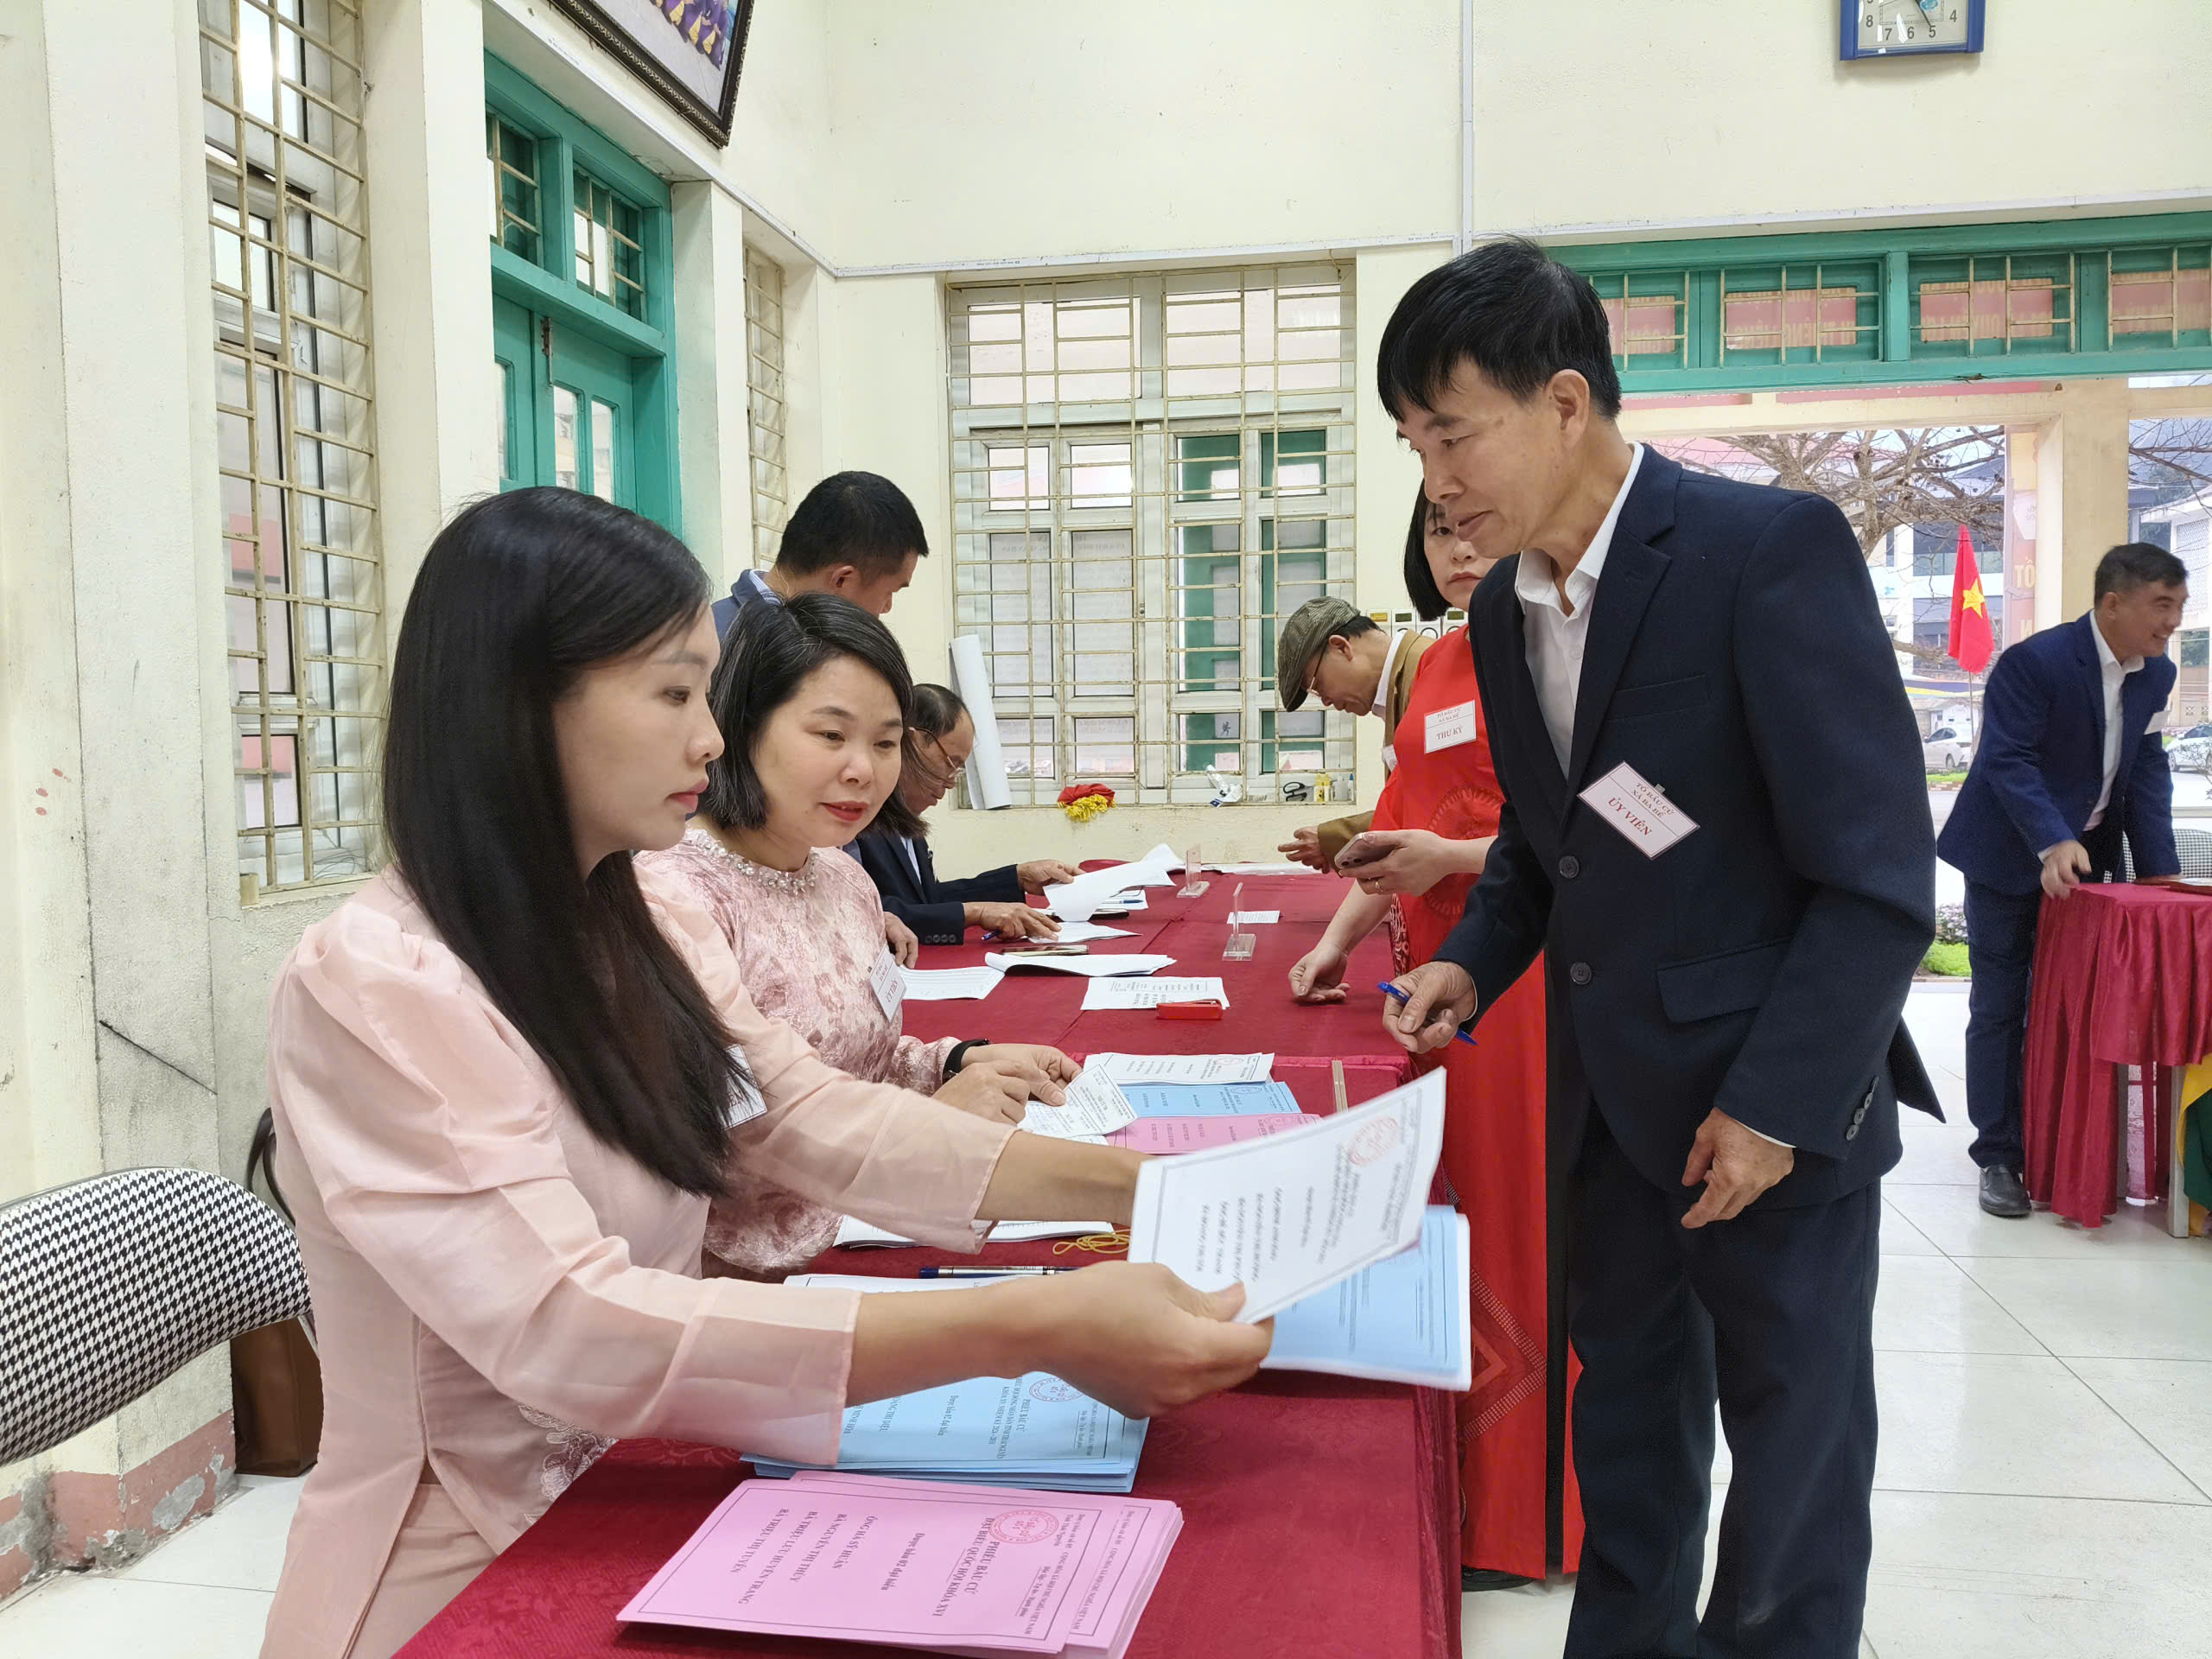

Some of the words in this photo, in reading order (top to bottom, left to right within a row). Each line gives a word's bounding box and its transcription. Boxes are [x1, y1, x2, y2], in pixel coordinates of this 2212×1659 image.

[1866, 15, 1873, 27] 8
[1949, 10, 1958, 22] 4
[1885, 28, 1892, 41] 7
[1907, 26, 1915, 39] 6
[1929, 25, 1936, 38] 5
[1437, 729, 1452, 740] THƯ
[1631, 790, 1643, 799] XÃ
[1642, 799, 1652, 809] BA
[1637, 782, 1649, 792] TỔ
[1646, 791, 1662, 804] BẦU
[1662, 805, 1675, 815] CỬ
[1608, 798, 1626, 812] ỦY
[1625, 810, 1652, 836] VIÊN
[760, 1518, 782, 1536] TRIỆU
[790, 1521, 811, 1538] TRIỆU
[860, 1516, 878, 1529] ÔNG
[982, 1517, 995, 1529] ĐẠI
[815, 1522, 841, 1548] NGUYỄN
[908, 1533, 925, 1548] Được
[973, 1530, 990, 1545] BIỂU
[747, 1539, 766, 1549] THỊ
[778, 1540, 795, 1554] LƯU
[802, 1550, 820, 1562] THỊ
[832, 1550, 853, 1568] HUÂN
[901, 1548, 916, 1559] bầu
[962, 1548, 980, 1567] QUỐC
[980, 1541, 1001, 1563] PHIẾU
[889, 1567, 902, 1578] đại
[953, 1567, 969, 1581] HỘI
[970, 1565, 988, 1580] BẦU
[880, 1578, 897, 1590] biểu
[964, 1582, 978, 1594] CỬ
[738, 1580, 765, 1604] TRANG
[940, 1582, 961, 1602] KHÓA
[932, 1604, 948, 1617] XVI
